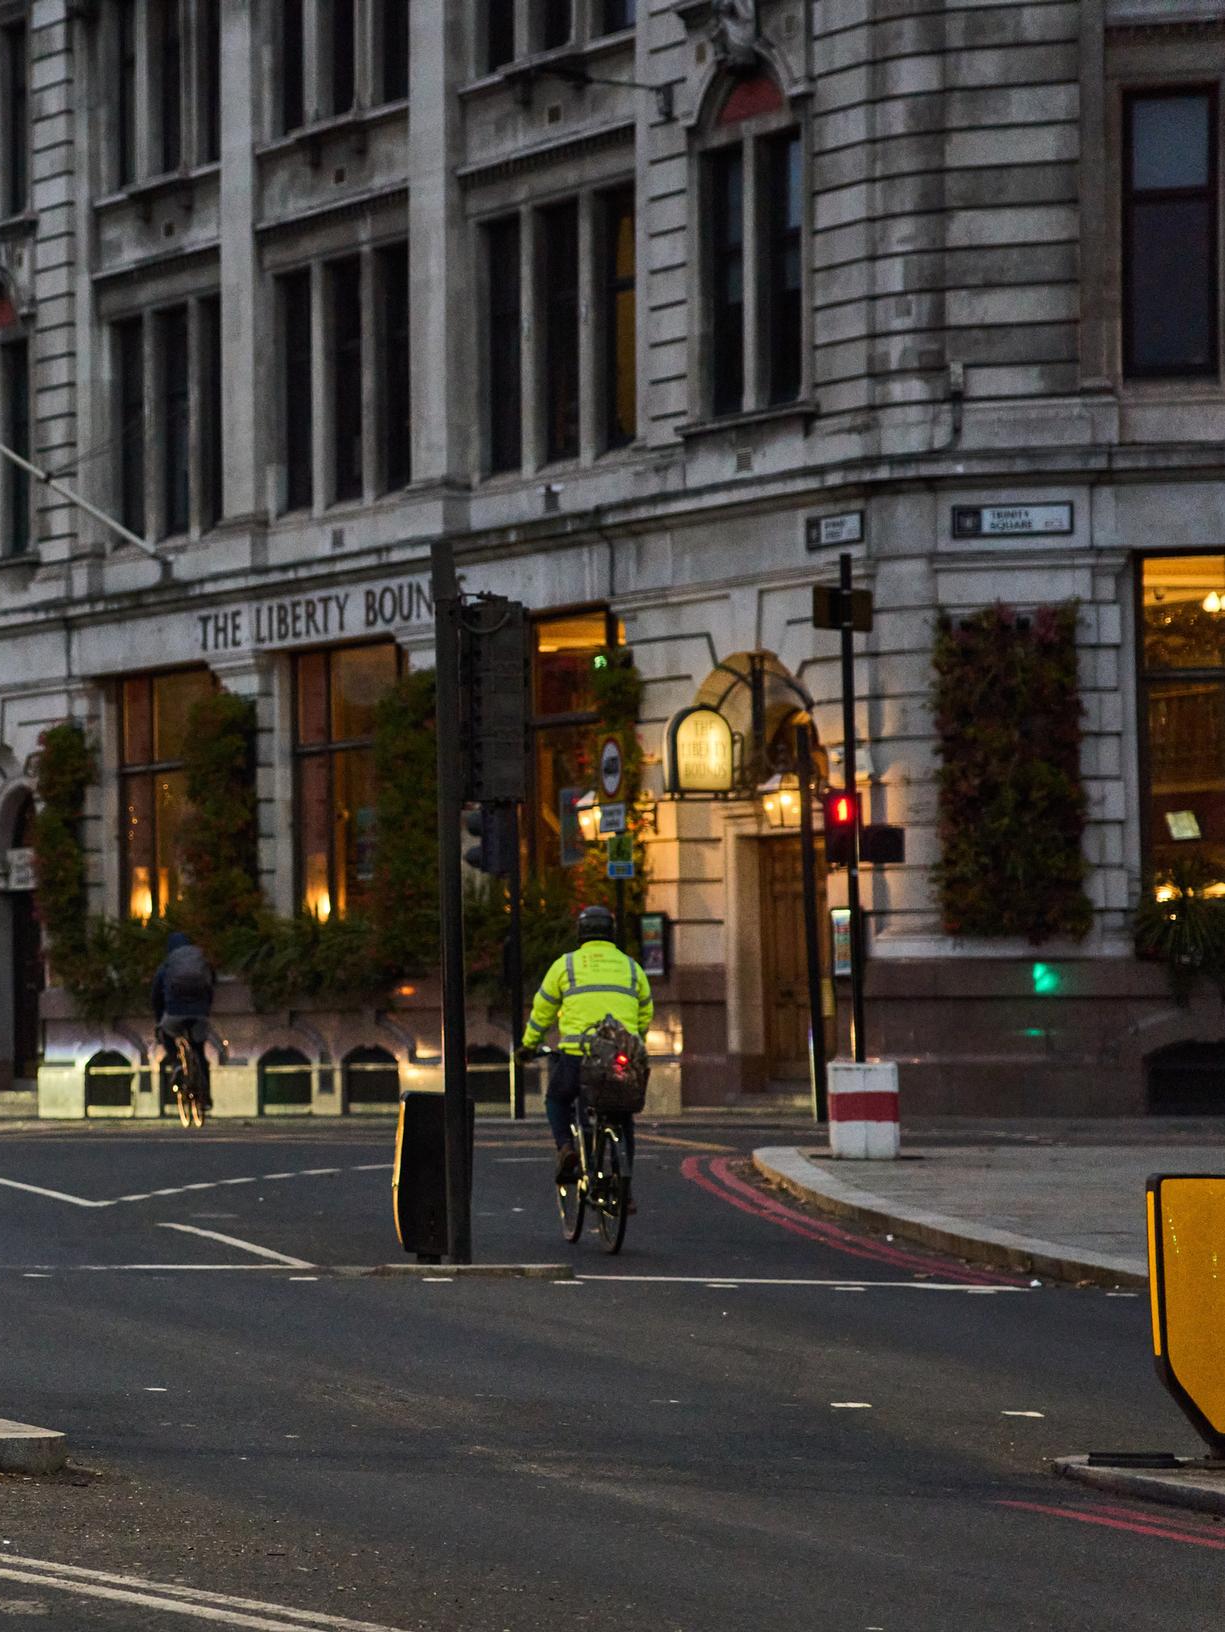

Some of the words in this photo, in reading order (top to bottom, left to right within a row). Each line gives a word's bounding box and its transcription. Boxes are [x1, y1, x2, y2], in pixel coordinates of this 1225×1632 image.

[990, 519, 1033, 530] SQUARE
[198, 610, 242, 651] THE
[255, 593, 349, 645] LIBERTY
[364, 575, 466, 626] BOUN
[694, 720, 716, 735] THE
